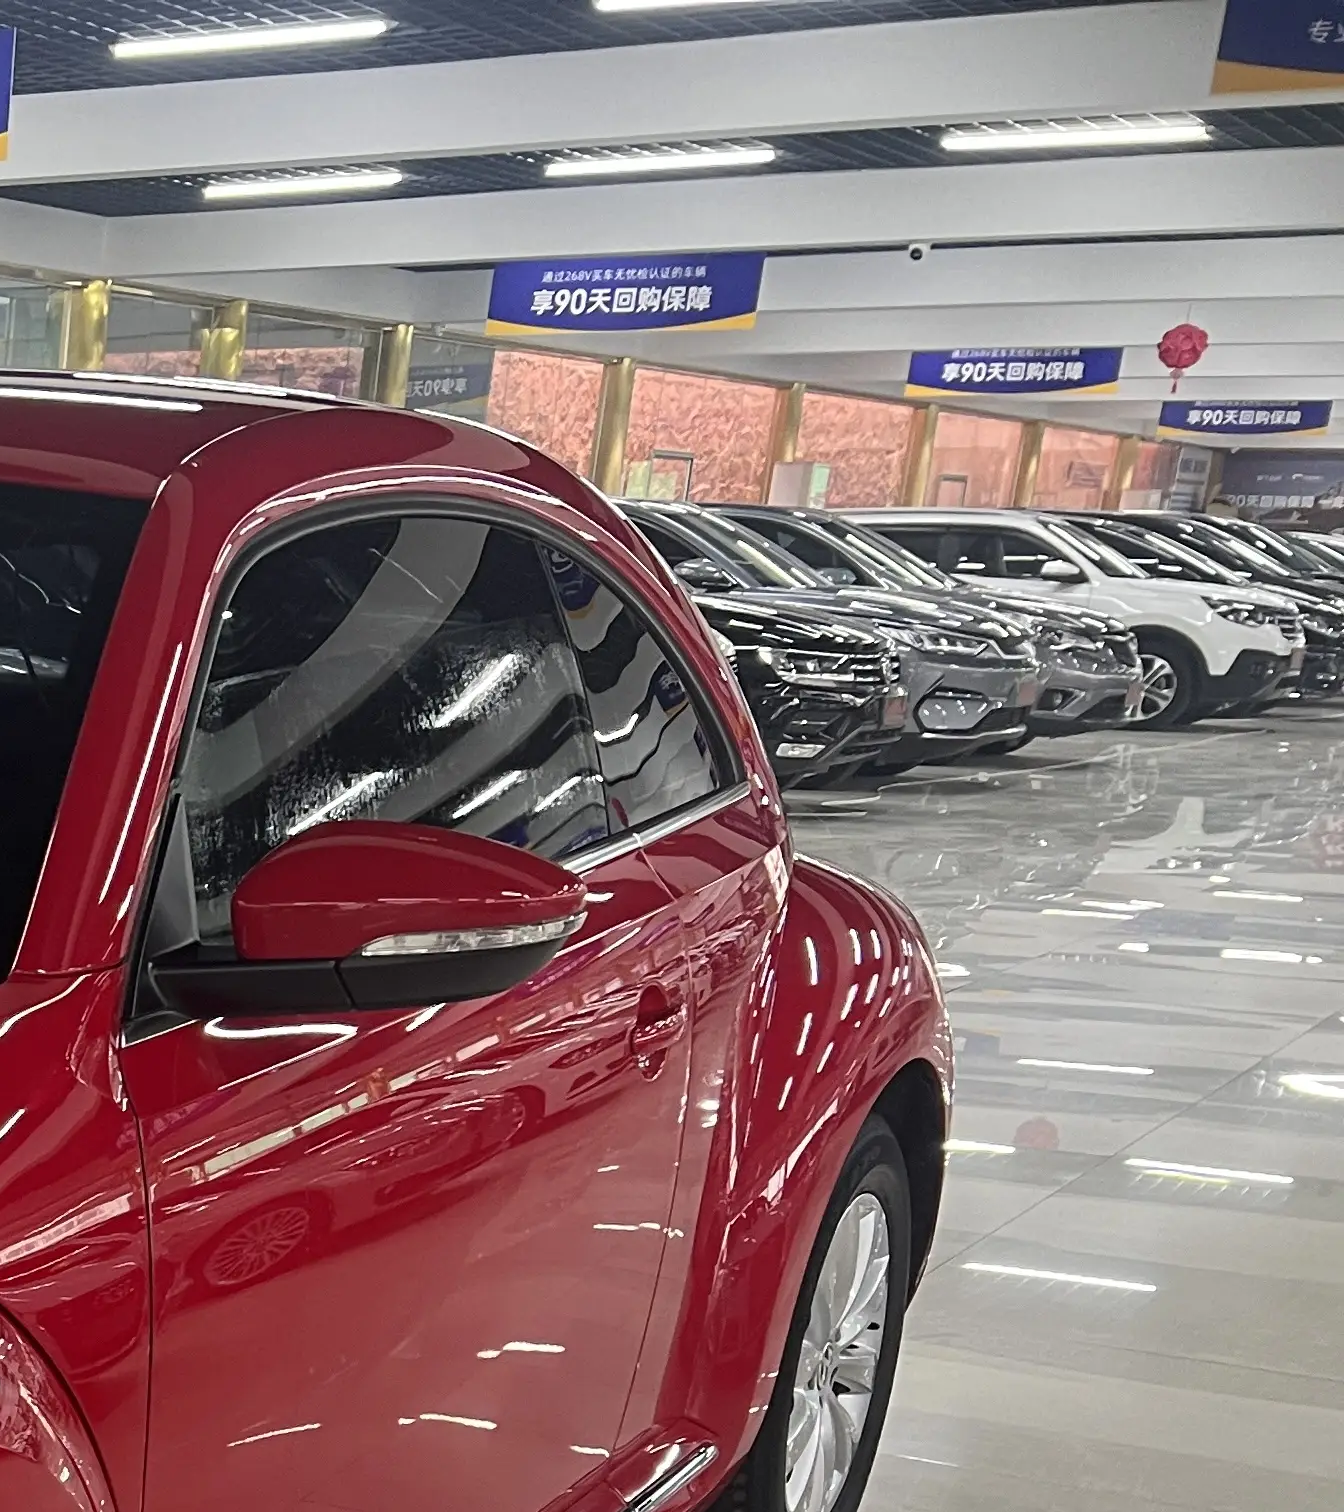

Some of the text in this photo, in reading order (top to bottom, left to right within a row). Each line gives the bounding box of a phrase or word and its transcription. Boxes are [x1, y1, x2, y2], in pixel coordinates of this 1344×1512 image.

[542, 265, 707, 284] 通过268V买车无忧检认证的车辆
[530, 285, 712, 316] 享90天回购保障
[941, 361, 1086, 383] 享90天回购保障
[1186, 409, 1302, 426] 享90天回购保障
